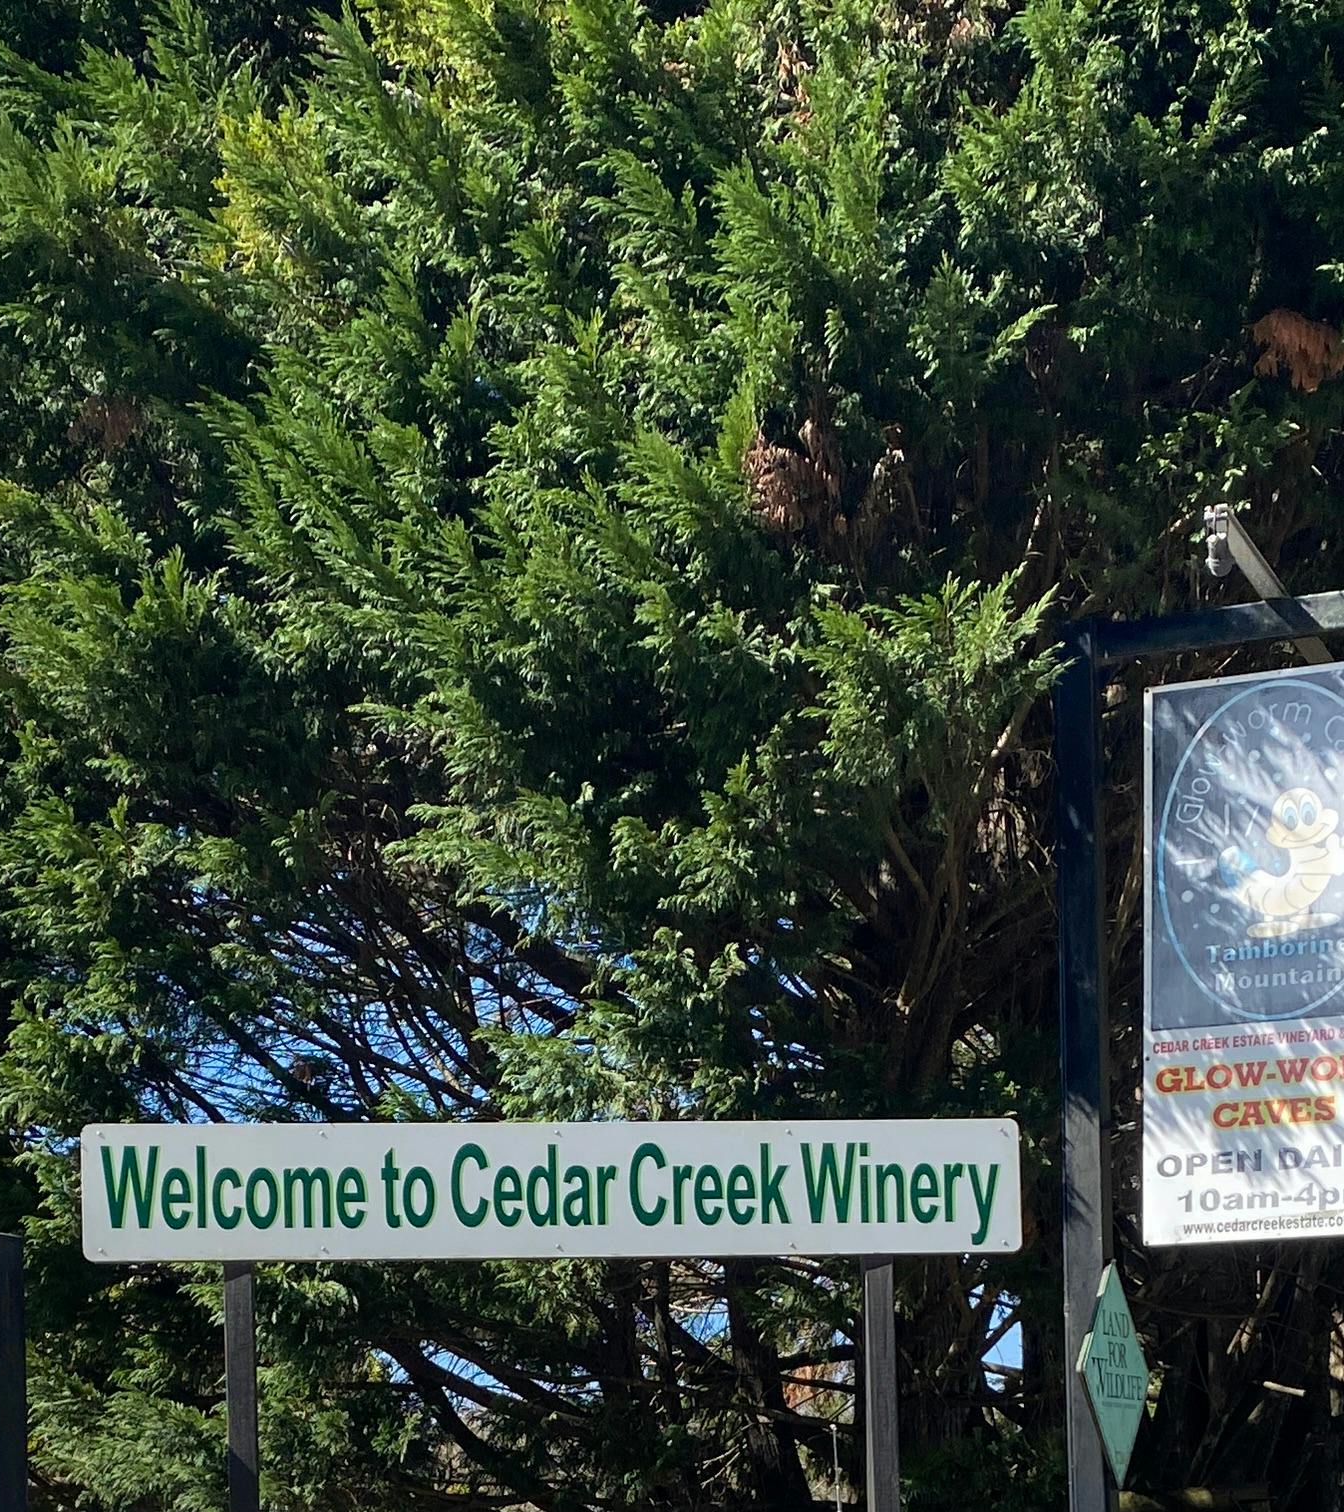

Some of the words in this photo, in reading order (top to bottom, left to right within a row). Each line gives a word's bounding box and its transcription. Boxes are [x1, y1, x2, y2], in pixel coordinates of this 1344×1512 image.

[1214, 965, 1344, 992] Mountain
[1152, 1037, 1190, 1054] CEDAR
[1192, 1034, 1229, 1051] CREEK
[1232, 1032, 1274, 1048] ESTATE
[1277, 1028, 1336, 1044] VINEYARD
[1212, 1096, 1336, 1128] CAVES
[1156, 1148, 1263, 1178] OPEN
[100, 1145, 367, 1230] Welcome
[381, 1147, 436, 1228] to
[450, 1142, 618, 1227] Cedar
[629, 1141, 792, 1226] Creek
[799, 1141, 1001, 1246] Winery
[1102, 1309, 1130, 1339] LAND
[1107, 1341, 1128, 1368] FOR
[1091, 1356, 1143, 1401] WILDLIFE
